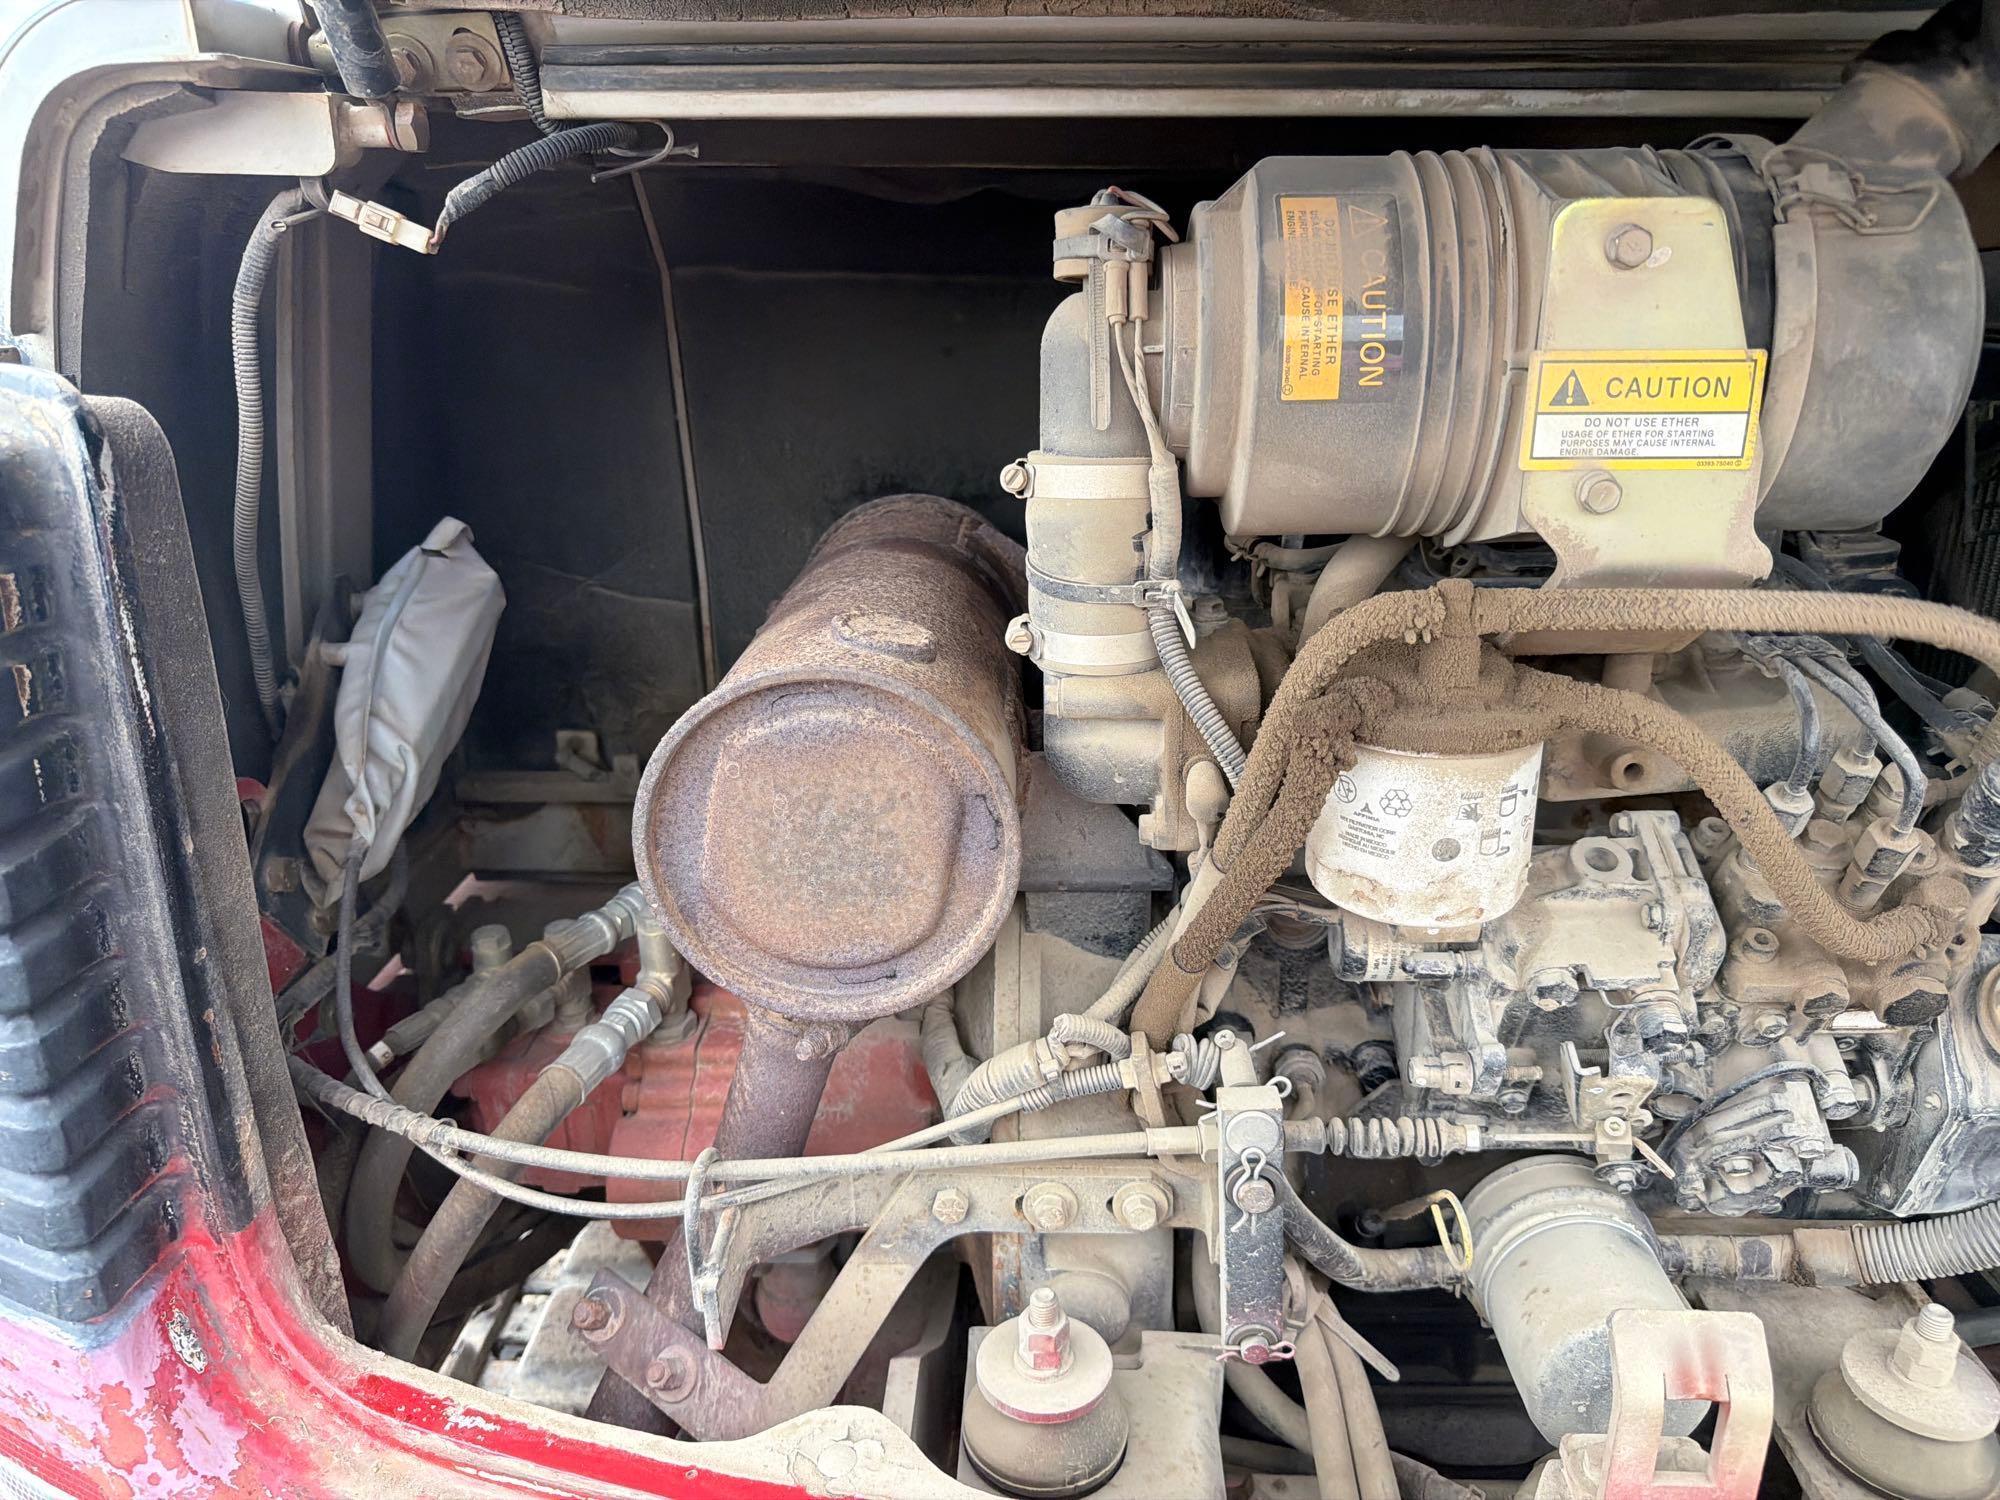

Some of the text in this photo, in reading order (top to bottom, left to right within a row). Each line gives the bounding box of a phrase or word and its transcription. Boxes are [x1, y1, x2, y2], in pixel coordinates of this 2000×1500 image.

[1301, 286, 1311, 321] CAUSE
[1359, 249, 1387, 387] CAUTION
[1299, 326, 1311, 381] INTERNAL
[1311, 321, 1322, 376] STARTING
[1326, 314, 1338, 365] ETHER
[1605, 376, 1731, 399] CAUTION
[1561, 429, 1714, 438] USAGE OF ETHER FOR STARTING
[1584, 417, 1700, 428] DO NOT USE ETHER
[1559, 447, 1639, 456] ENGINE DAMAGE.
[1560, 439, 1716, 447] PURPOSES MAY CAUSE INTERNAL
